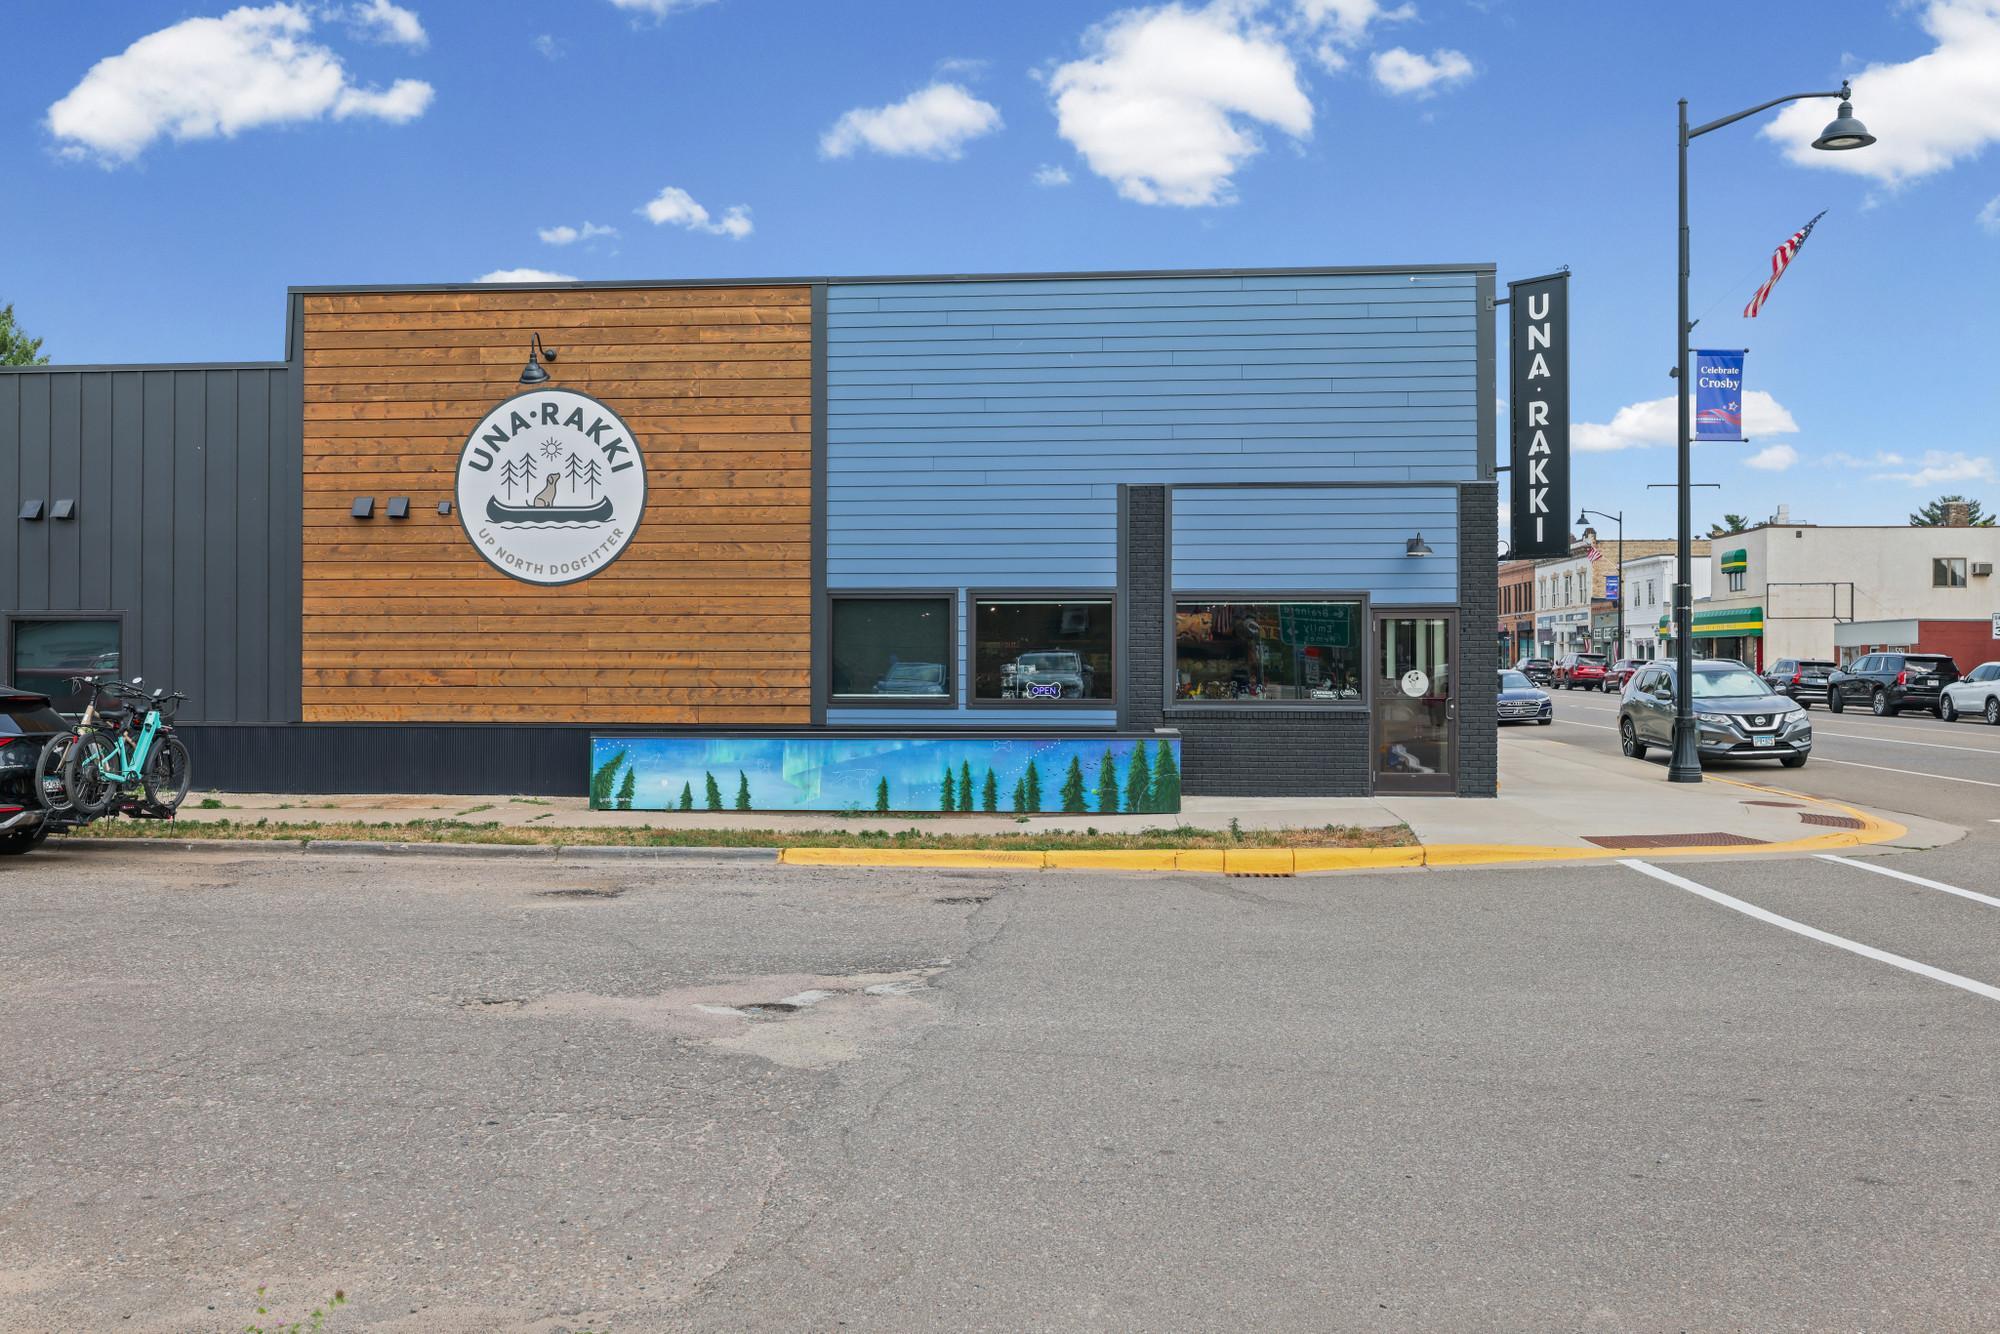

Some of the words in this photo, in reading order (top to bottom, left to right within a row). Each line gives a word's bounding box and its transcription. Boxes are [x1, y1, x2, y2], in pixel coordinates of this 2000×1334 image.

[1700, 366, 1739, 375] Celebrate
[1699, 377, 1740, 391] Crosby
[478, 527, 495, 547] UP
[495, 546, 544, 575] NORTH
[550, 527, 624, 575] DOGFITTER
[1031, 686, 1057, 695] OPEN
